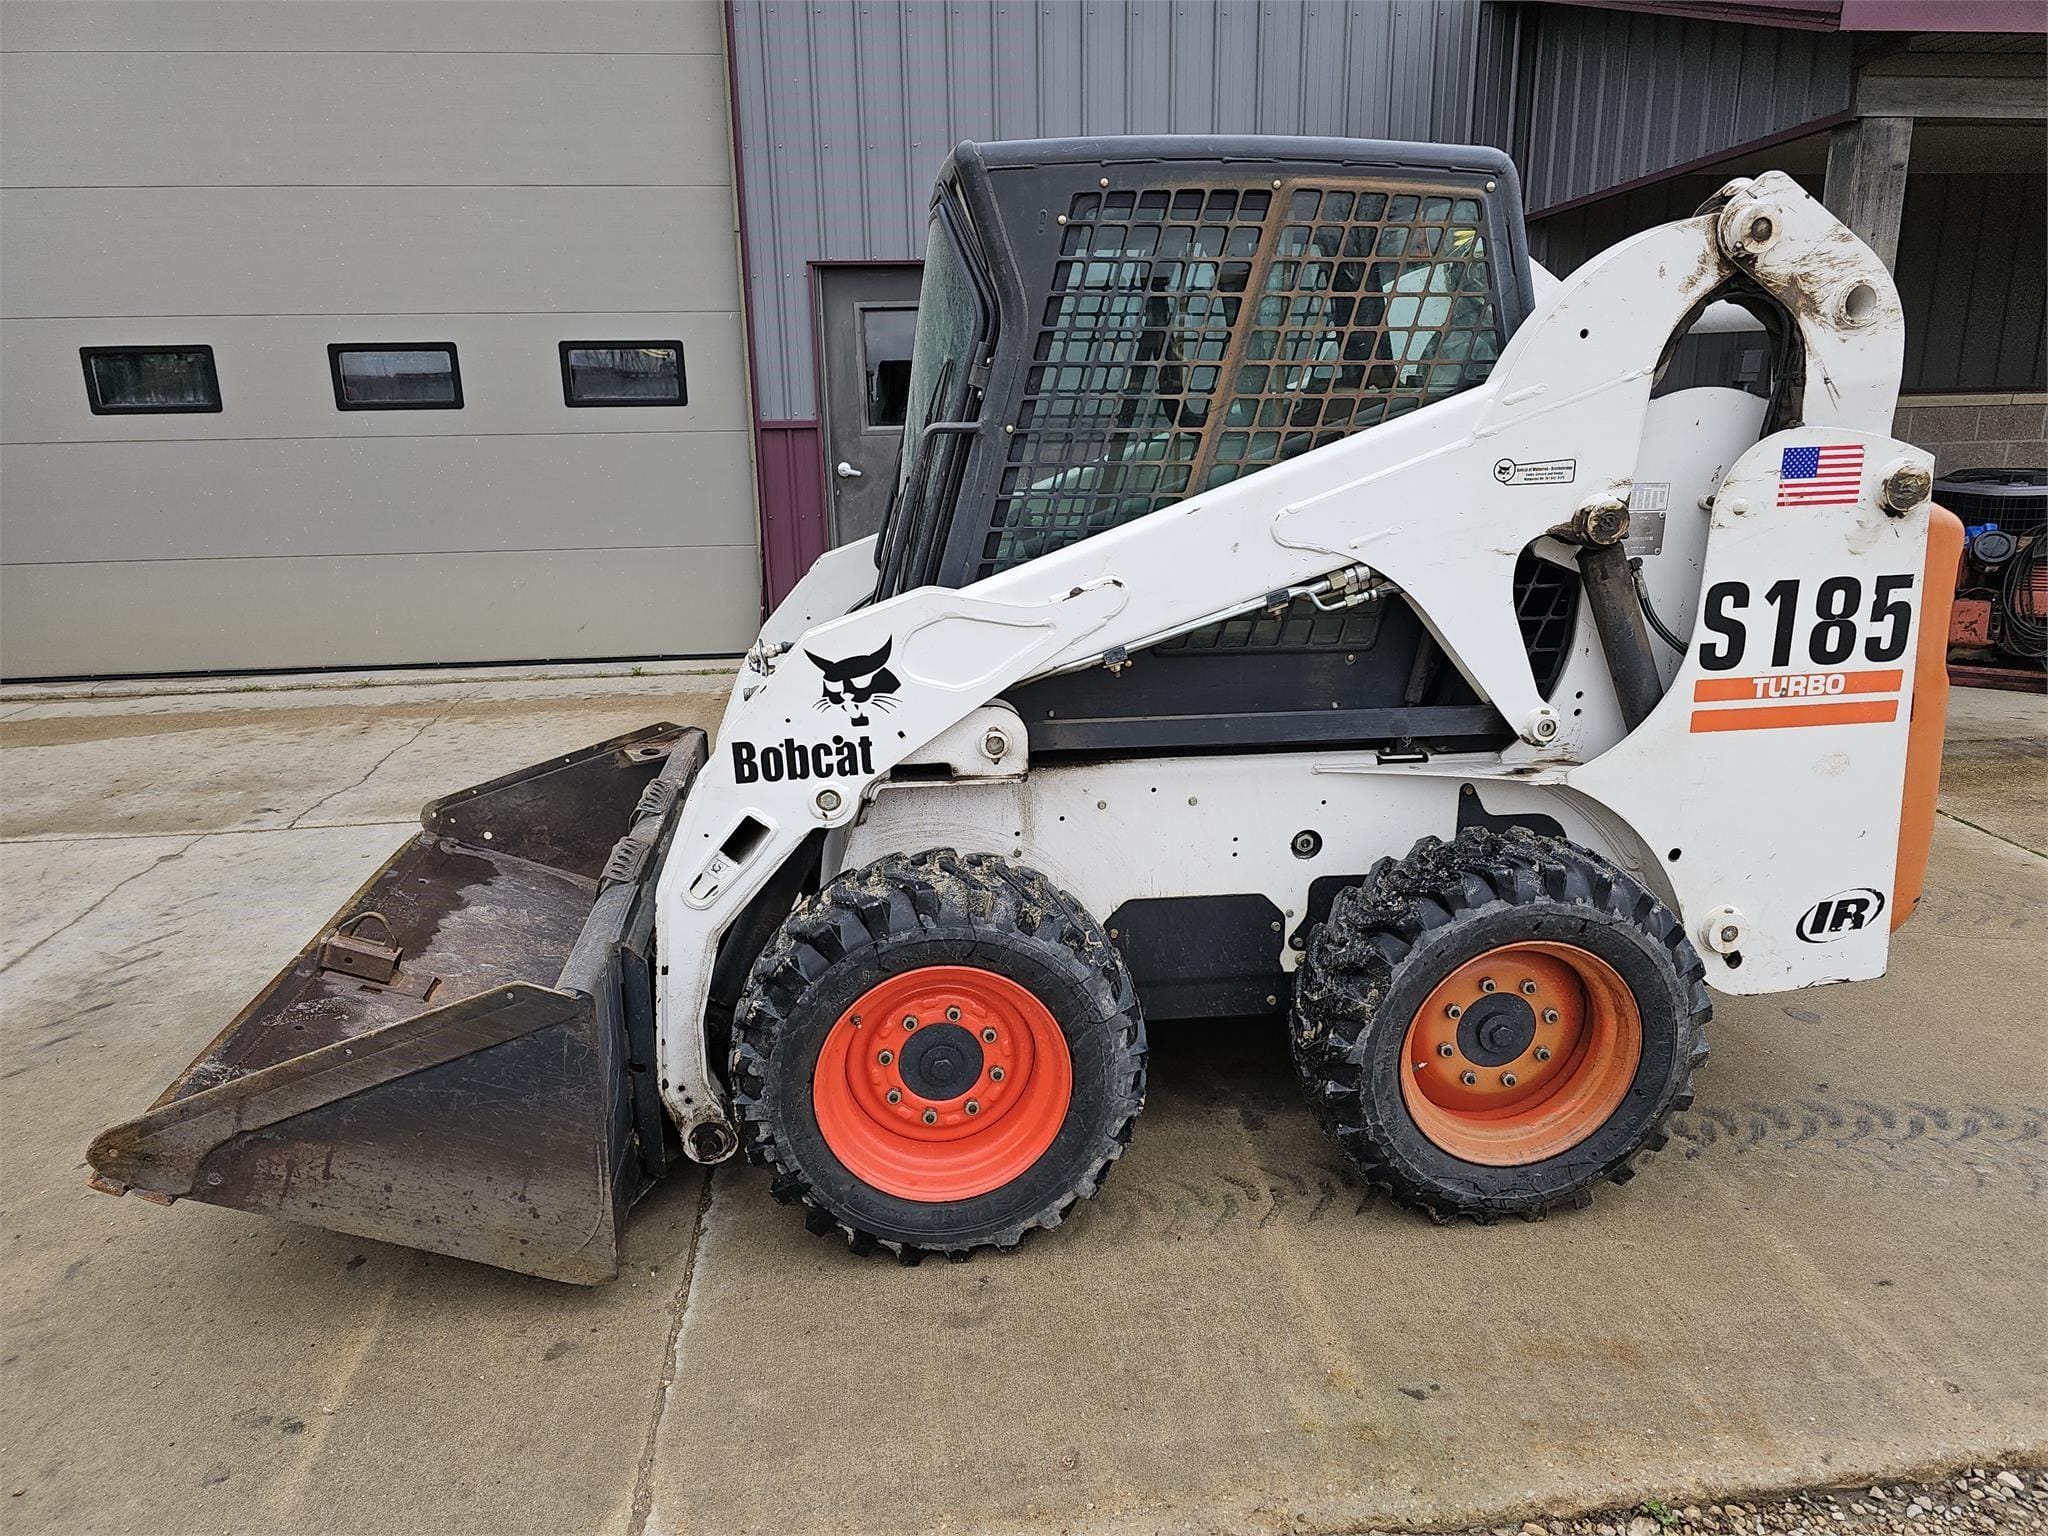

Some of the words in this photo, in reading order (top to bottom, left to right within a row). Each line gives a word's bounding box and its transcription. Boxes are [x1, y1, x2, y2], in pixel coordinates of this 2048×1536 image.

[1699, 573, 1915, 671] S185
[1752, 673, 1846, 699] TURBO
[732, 735, 876, 786] Bobcat
[1809, 898, 1870, 935] IR
